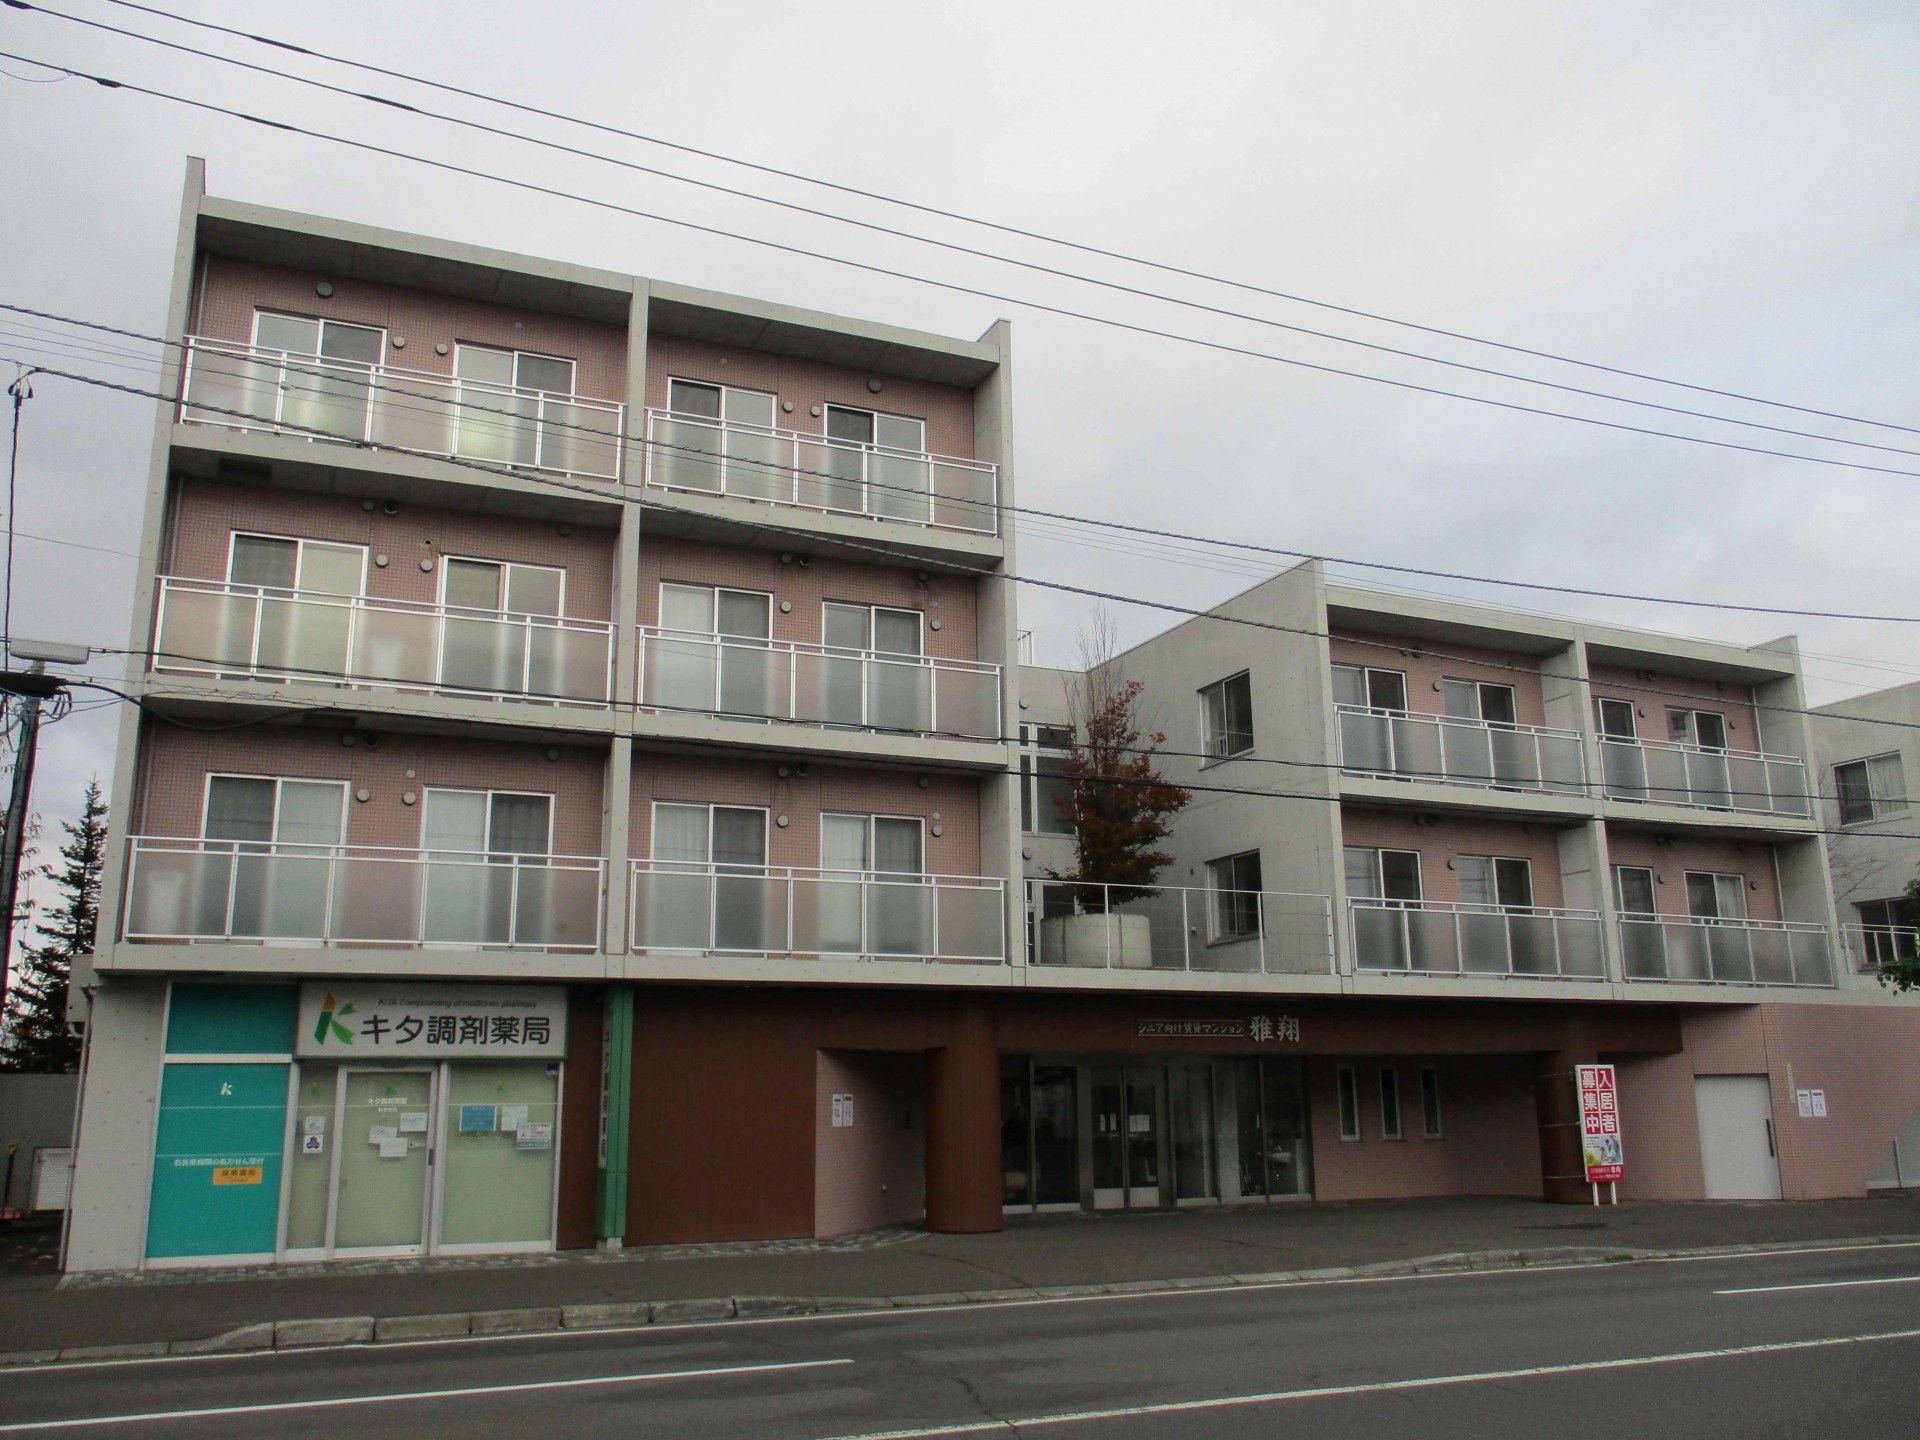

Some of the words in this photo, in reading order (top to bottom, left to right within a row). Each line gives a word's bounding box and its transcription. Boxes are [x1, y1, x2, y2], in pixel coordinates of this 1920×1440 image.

[361, 1014, 550, 1045] キタ調剤薬局
[1250, 1015, 1299, 1042] 雅翔
[1581, 1070, 1599, 1133] 募集中
[1600, 1070, 1616, 1133] 入居者
